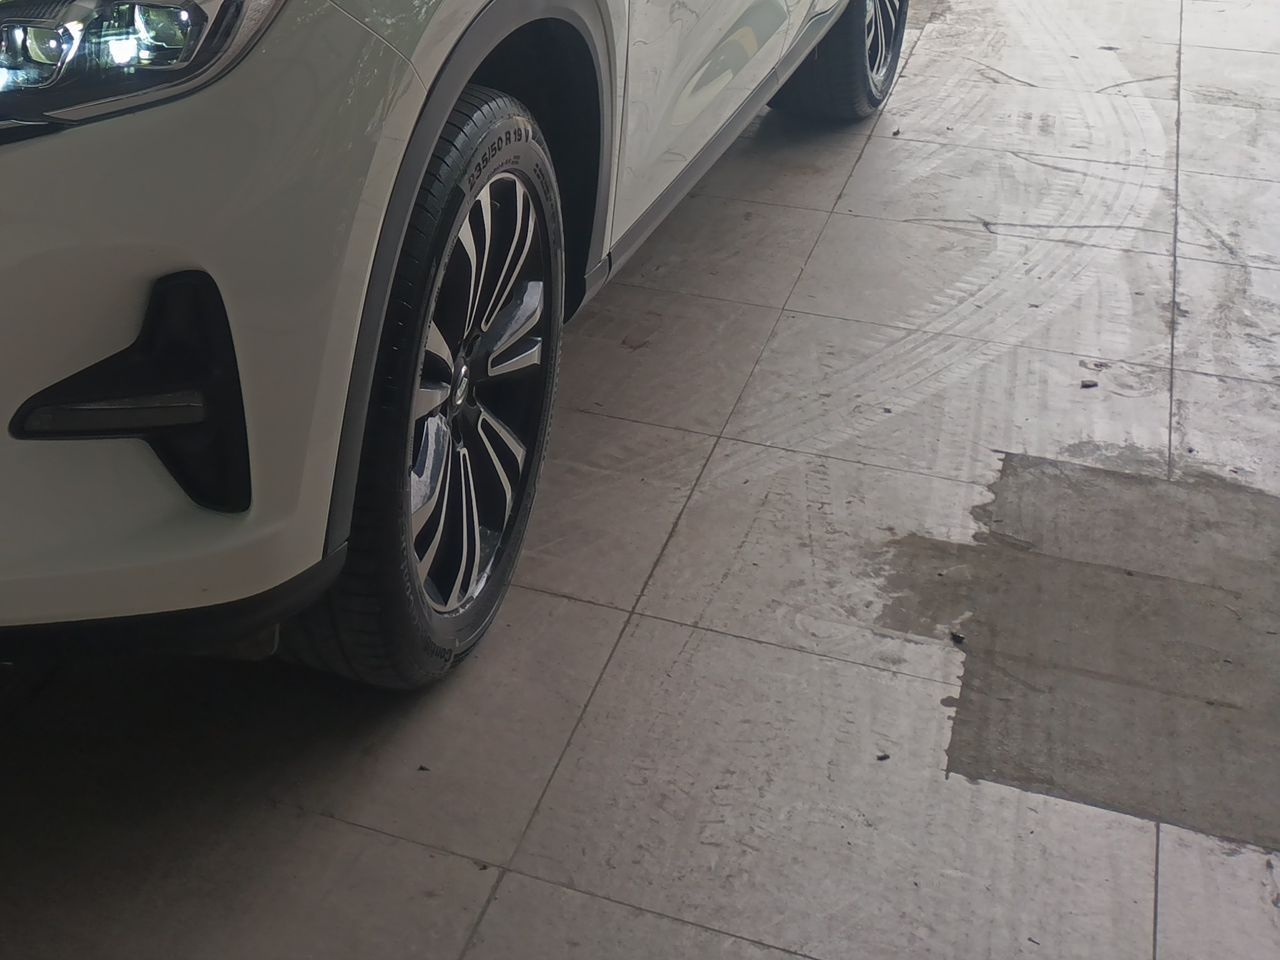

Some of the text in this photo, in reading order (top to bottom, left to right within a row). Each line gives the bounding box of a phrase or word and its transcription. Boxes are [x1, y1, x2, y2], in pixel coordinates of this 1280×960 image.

[468, 135, 503, 193] 235/50
[505, 130, 511, 146] R
[514, 127, 522, 142] 19
